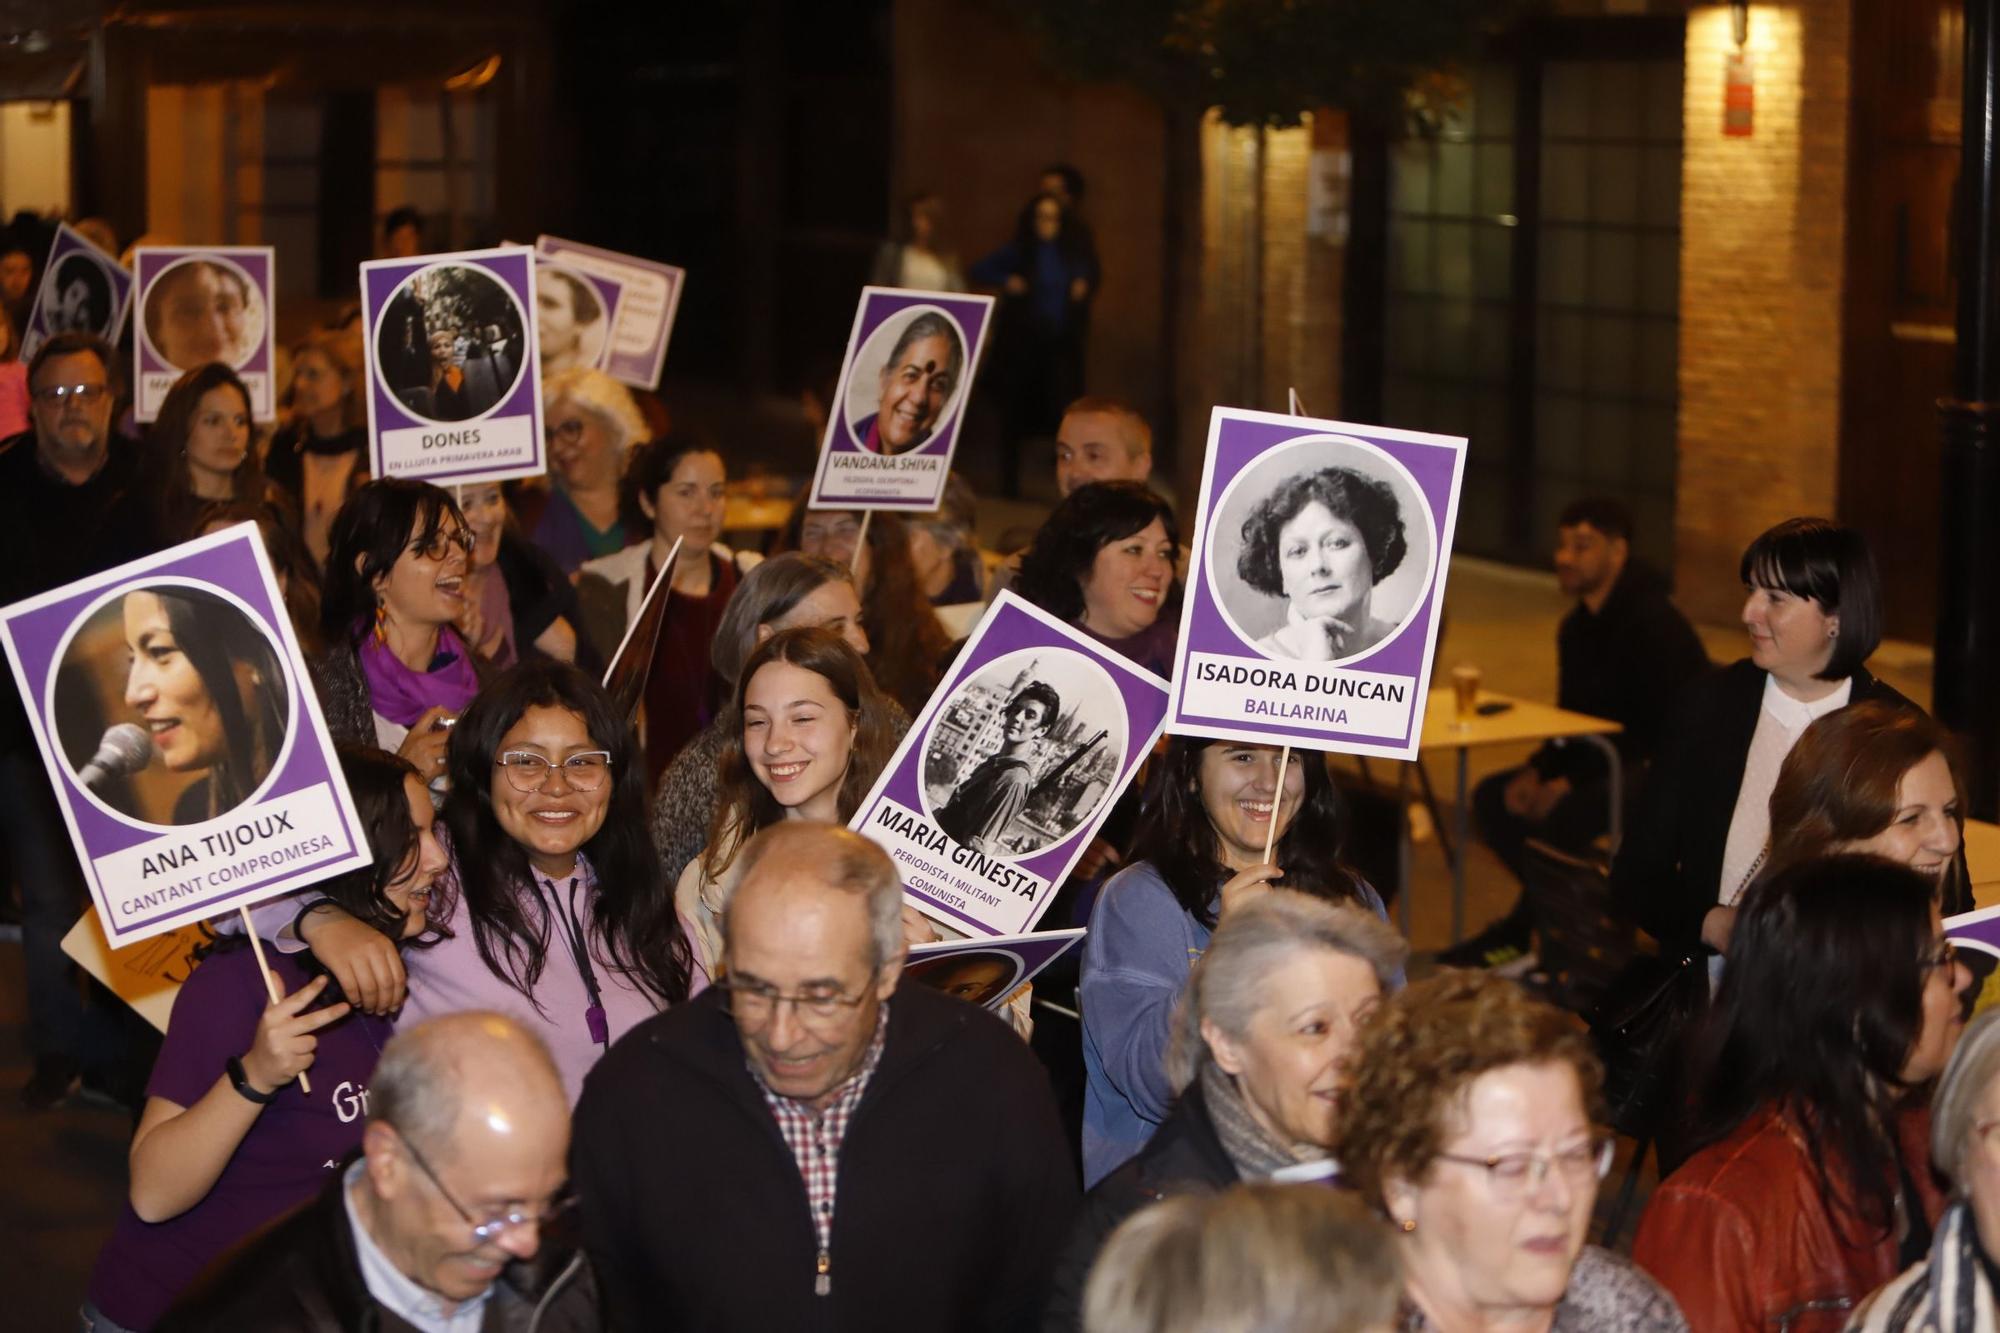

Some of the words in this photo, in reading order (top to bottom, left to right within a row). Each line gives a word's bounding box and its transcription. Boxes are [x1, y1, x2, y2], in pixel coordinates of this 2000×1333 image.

[422, 429, 481, 449] DONES
[389, 461, 401, 470] EN
[404, 457, 438, 468] LLUITA
[439, 450, 494, 464] PRIMAVERA
[496, 447, 522, 457] ARAB
[833, 455, 896, 470] VANDANA
[899, 458, 937, 471] SHIVA
[1196, 662, 1297, 690] ISADORA
[1304, 675, 1404, 703] DUNCAN
[1244, 699, 1348, 724] BALLARINA
[142, 844, 199, 879] ANA
[200, 810, 294, 857] TIJOUX
[876, 805, 950, 856] MARIA
[951, 847, 1039, 902] GINESTA
[121, 876, 204, 915] CANTANT
[208, 834, 334, 886] COMPROMESA
[893, 848, 948, 881] PERIODISTA
[949, 876, 954, 885] I
[954, 878, 1002, 908] MILITANT
[909, 875, 966, 910] COMUNISTA
